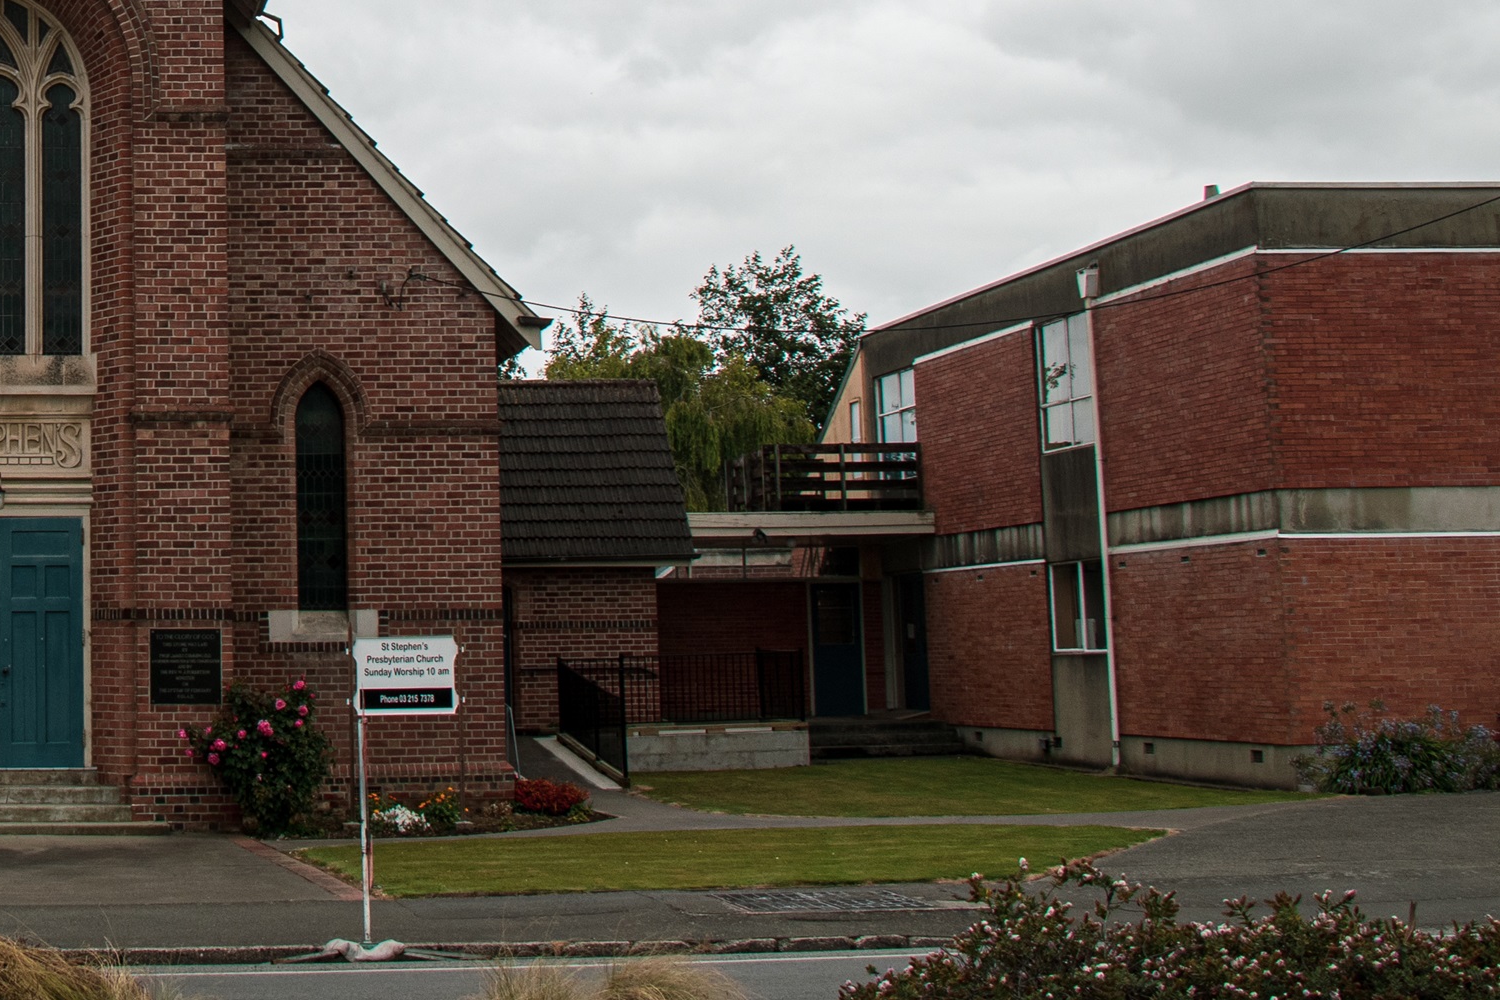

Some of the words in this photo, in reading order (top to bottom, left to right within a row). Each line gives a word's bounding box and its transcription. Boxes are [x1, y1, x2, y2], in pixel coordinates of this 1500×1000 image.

[381, 642, 389, 651] St
[391, 642, 428, 652] Stephen's
[367, 655, 414, 665] Presbyterian
[416, 654, 443, 663] Church
[364, 668, 392, 678] Sunday
[394, 667, 425, 677] Worship
[426, 667, 436, 675] 10
[380, 694, 398, 703] Phone
[399, 694, 407, 703] 03
[407, 694, 418, 703] 215
[420, 694, 435, 703] 7378
